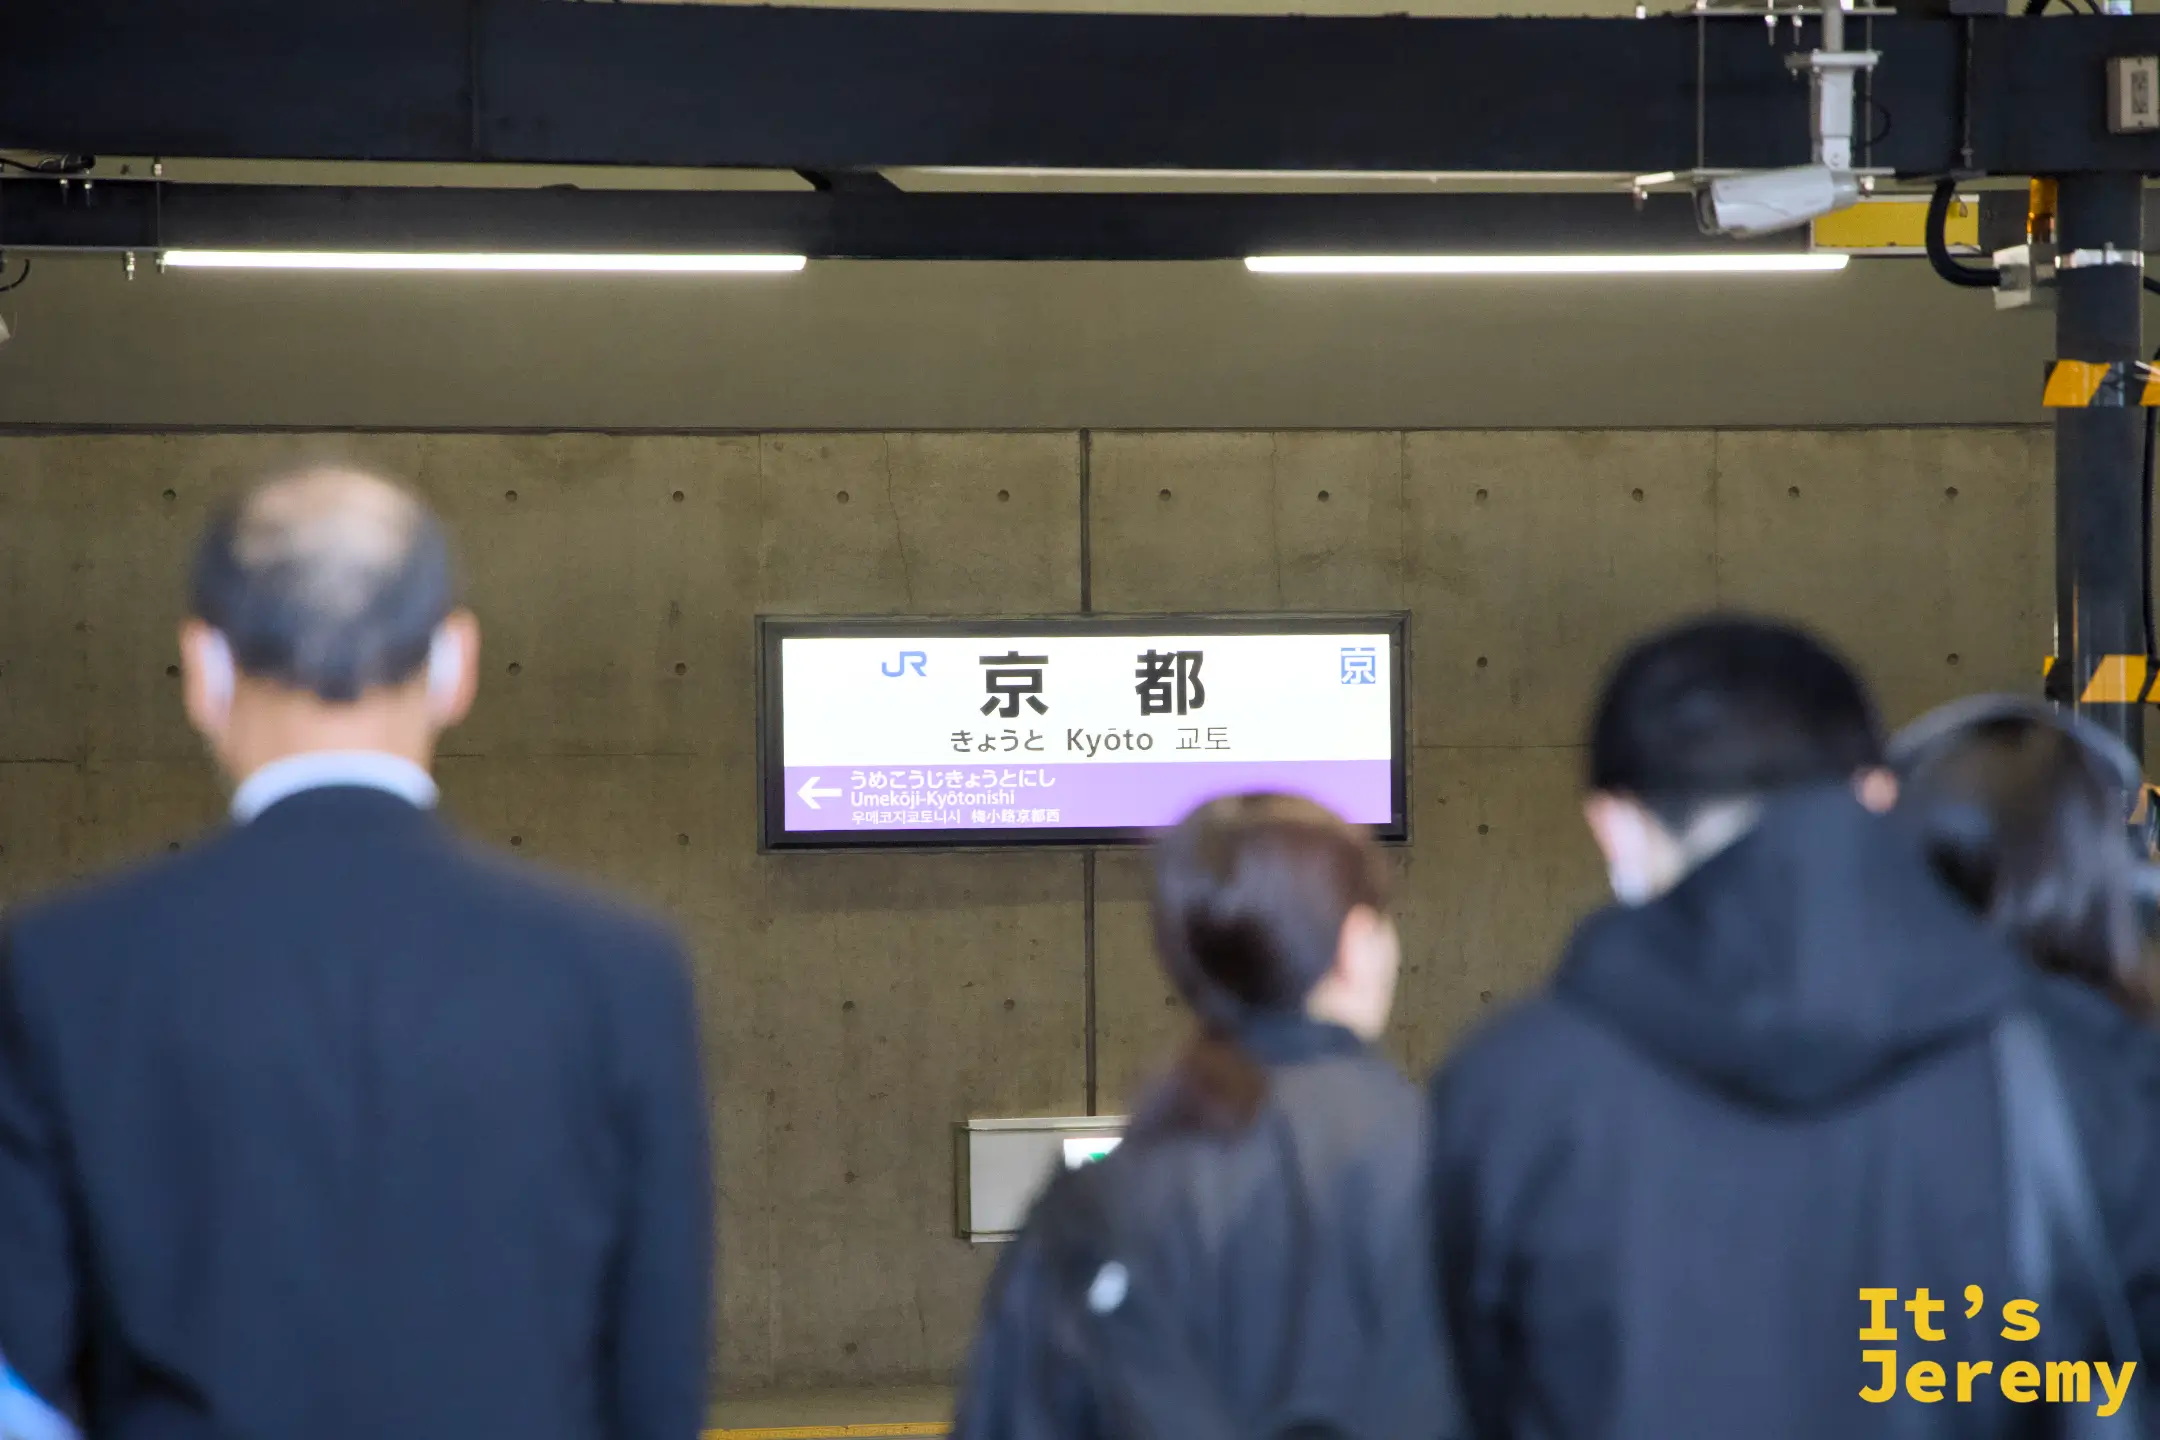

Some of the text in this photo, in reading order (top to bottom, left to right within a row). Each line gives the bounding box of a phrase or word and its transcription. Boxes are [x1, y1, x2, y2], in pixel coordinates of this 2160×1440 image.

[881, 650, 928, 678] JR
[949, 726, 1232, 758] きょうと Kyōto 교토
[849, 768, 1056, 790] うめこうじきょうとにし
[970, 807, 1061, 824] 梅小路京都西
